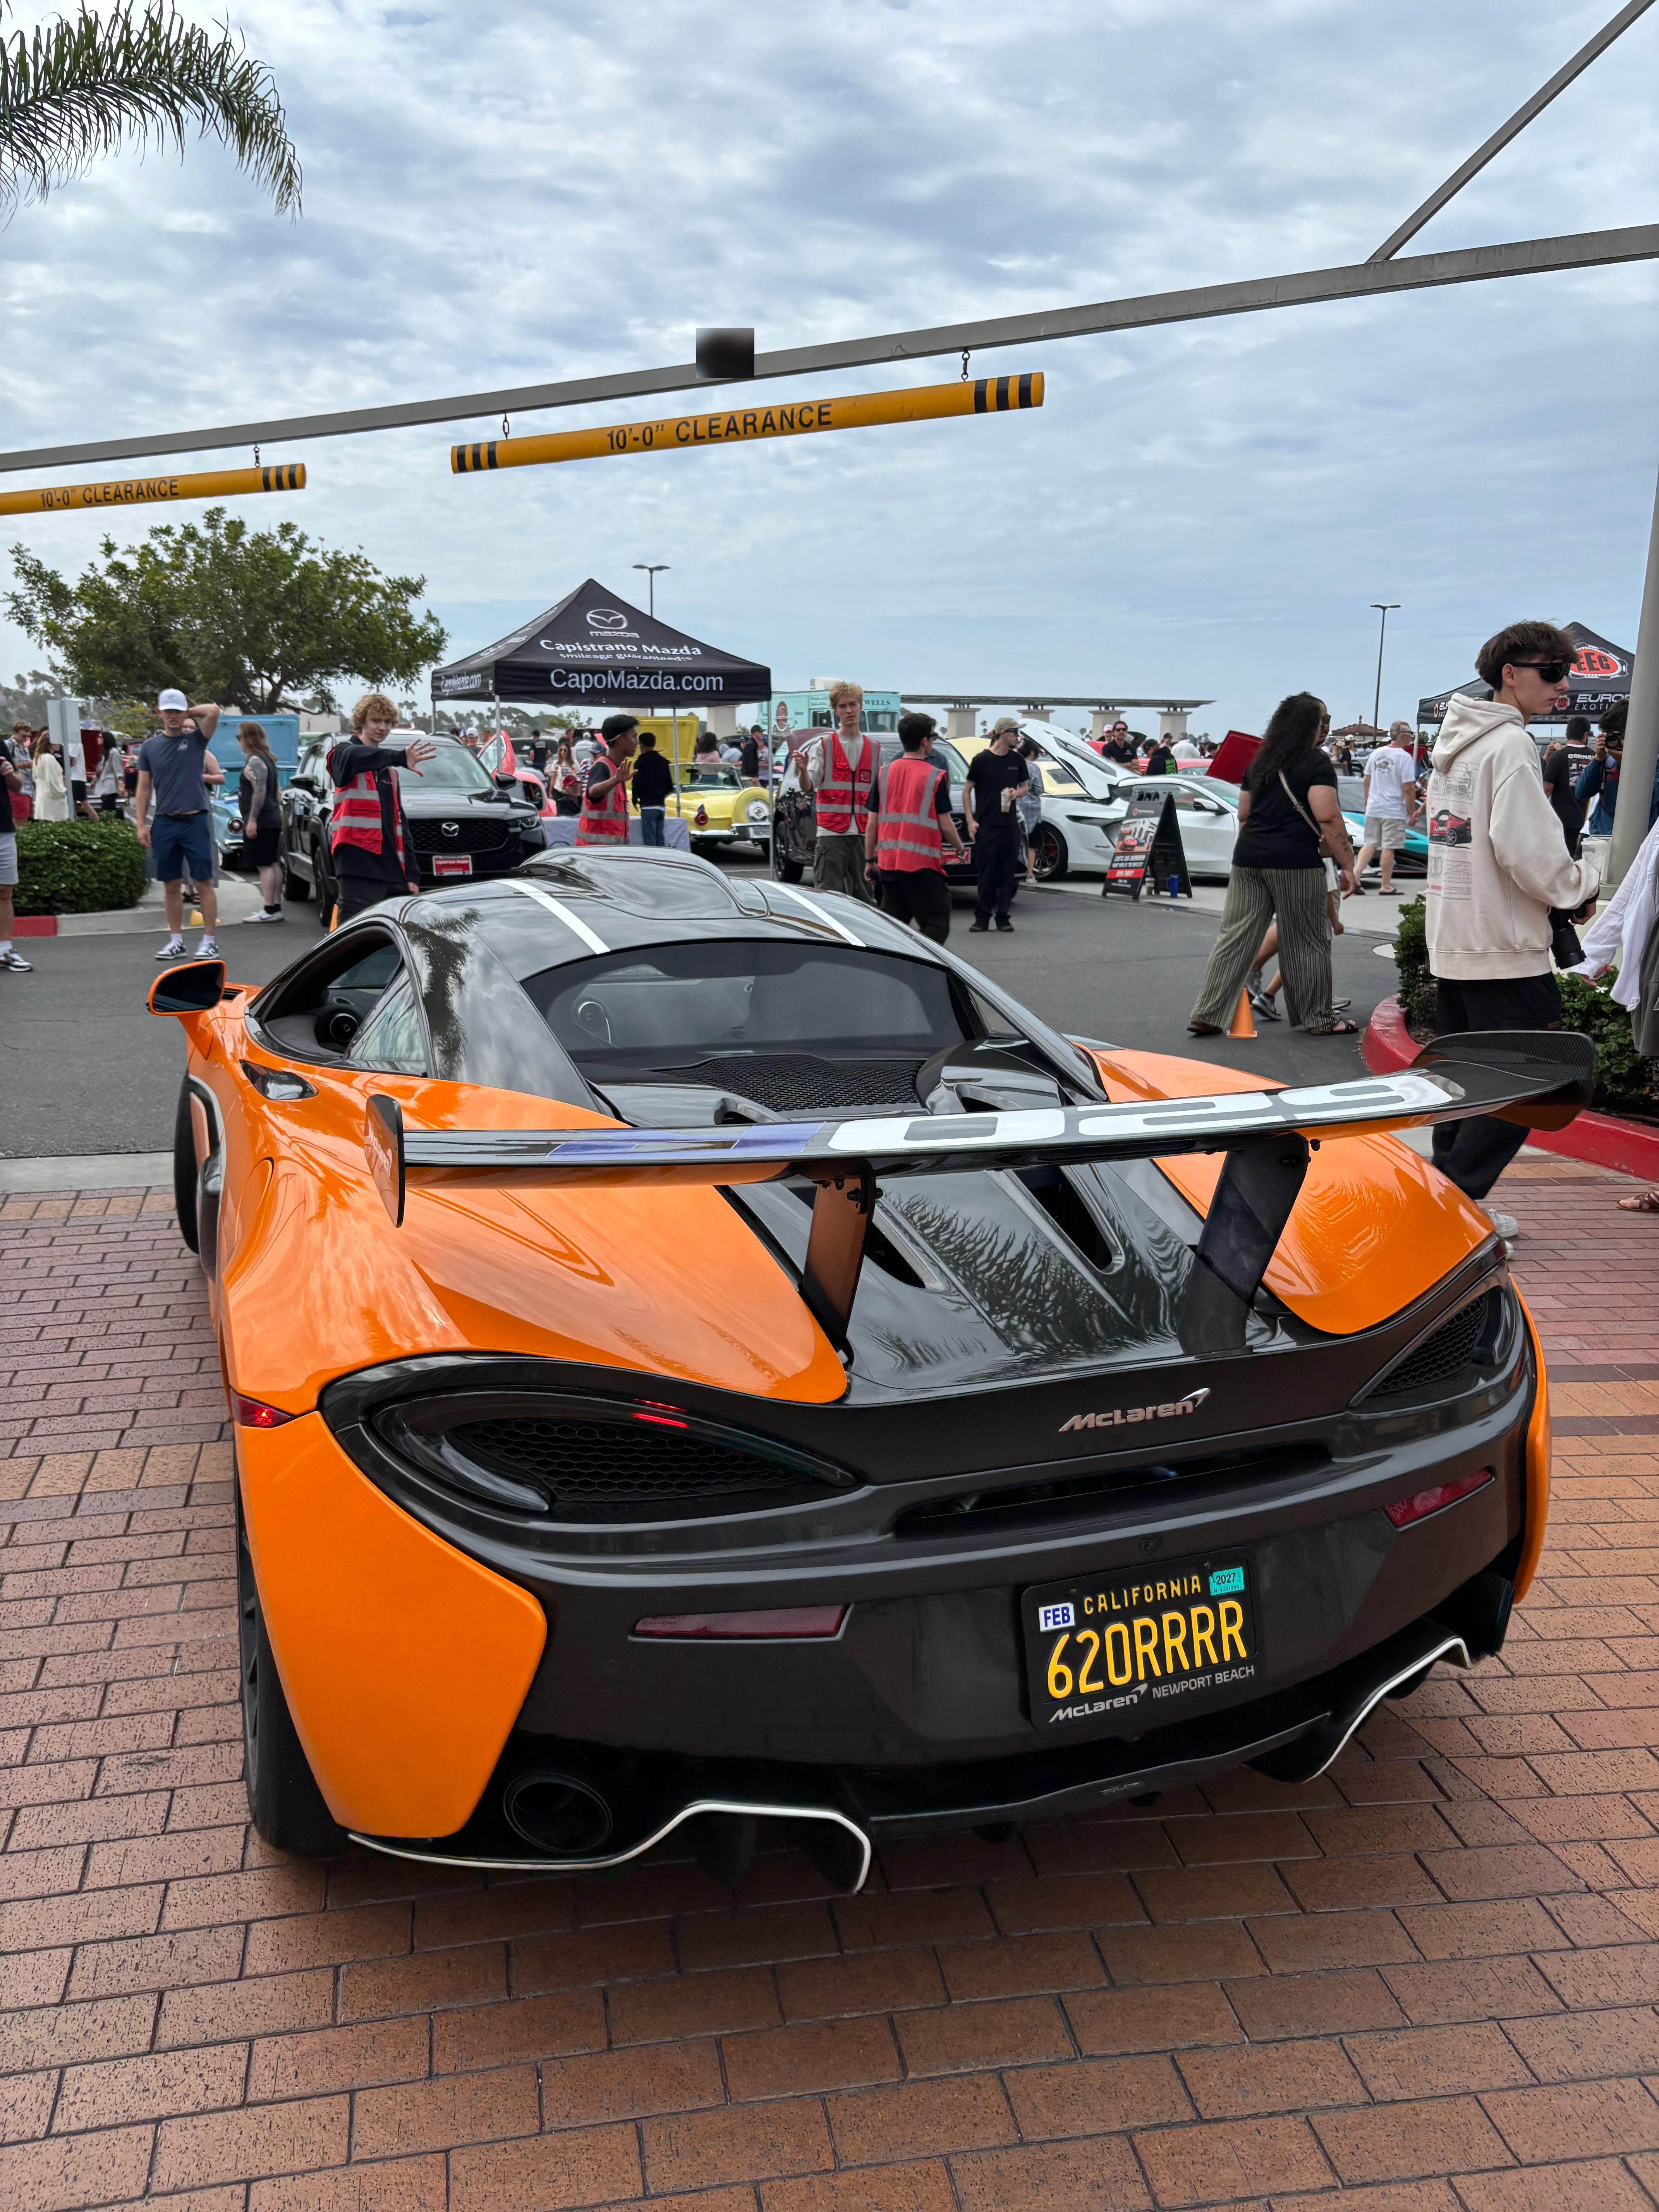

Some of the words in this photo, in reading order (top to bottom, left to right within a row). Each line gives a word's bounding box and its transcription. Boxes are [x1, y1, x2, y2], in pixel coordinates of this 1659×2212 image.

[676, 404, 831, 442] CLEARANCE
[83, 479, 179, 503] CLEARANCE
[540, 640, 637, 653] Capistrano
[642, 644, 702, 655] Mazda
[550, 669, 723, 693] CapoMazda.com
[1059, 1401, 1193, 1432] McLaren
[1216, 1573, 1236, 1585] 2027
[1084, 1575, 1201, 1615] CALIFORNIA
[1043, 1603, 1071, 1627] FEB
[1048, 1693, 1138, 1723] McLaren
[1152, 1674, 1212, 1699] NEWPORT
[1215, 1665, 1255, 1685] BEACH
